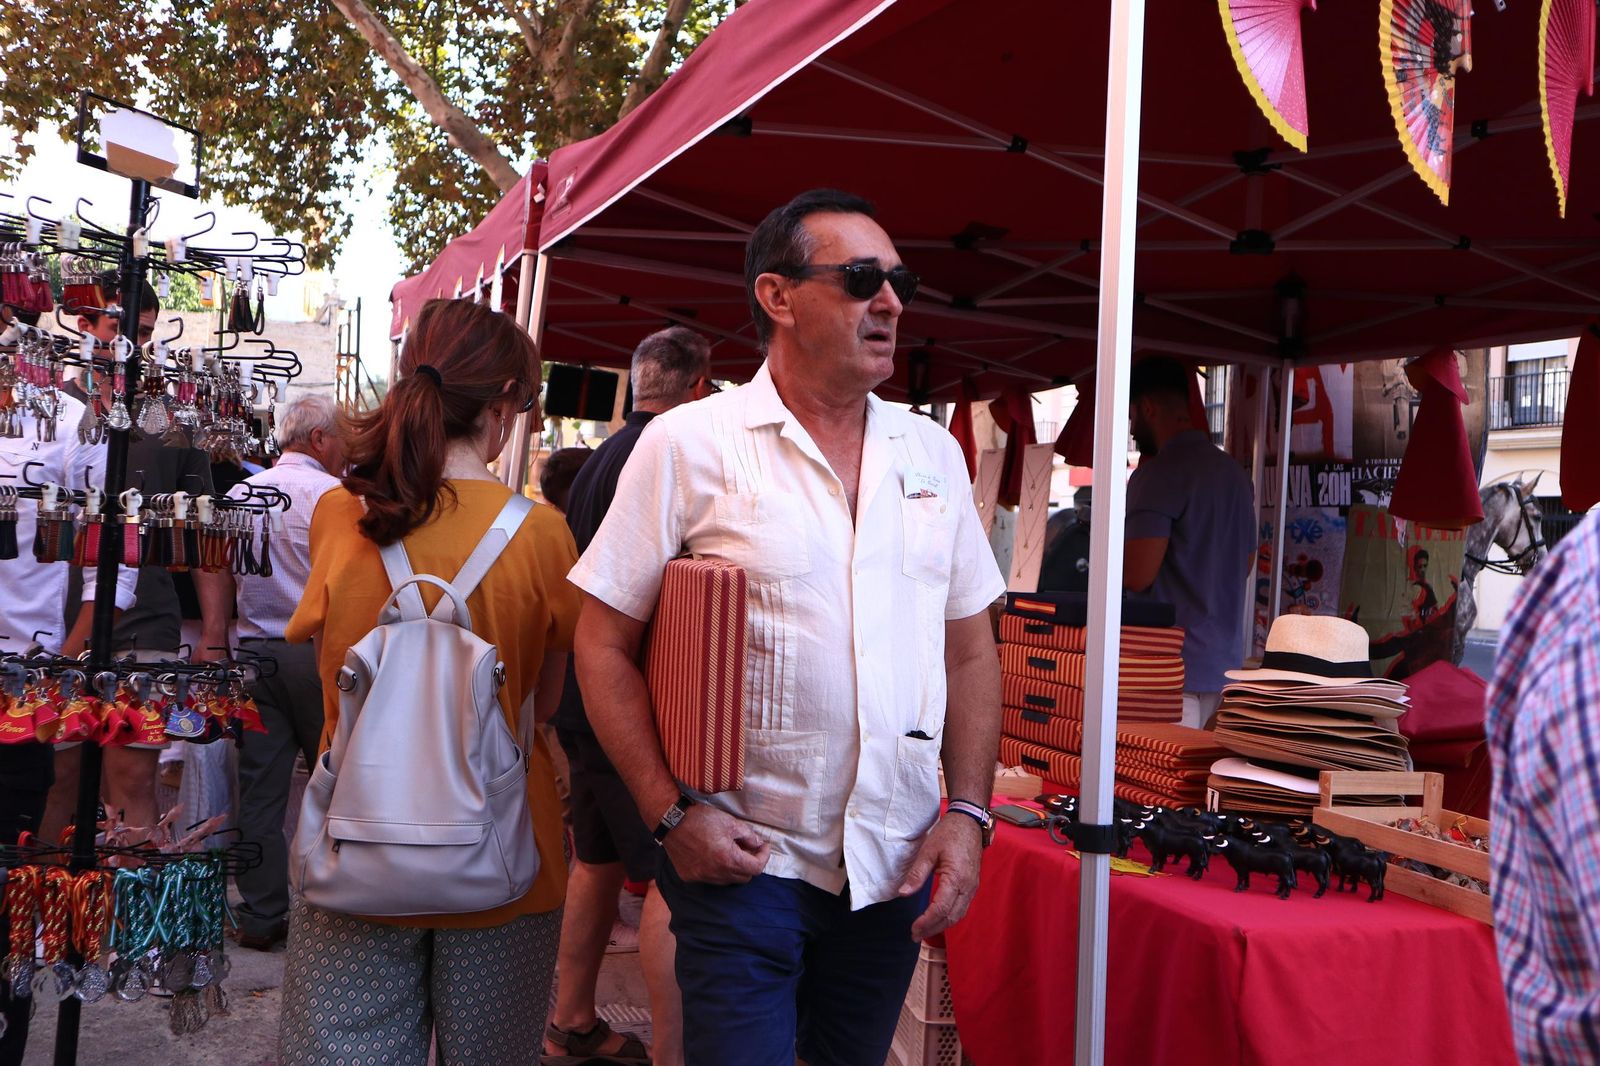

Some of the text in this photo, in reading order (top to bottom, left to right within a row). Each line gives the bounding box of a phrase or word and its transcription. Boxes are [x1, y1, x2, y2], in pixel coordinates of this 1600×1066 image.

[1324, 463, 1345, 471] A LAS
[1351, 465, 1401, 480] HACIE
[1318, 471, 1352, 506] 20H
